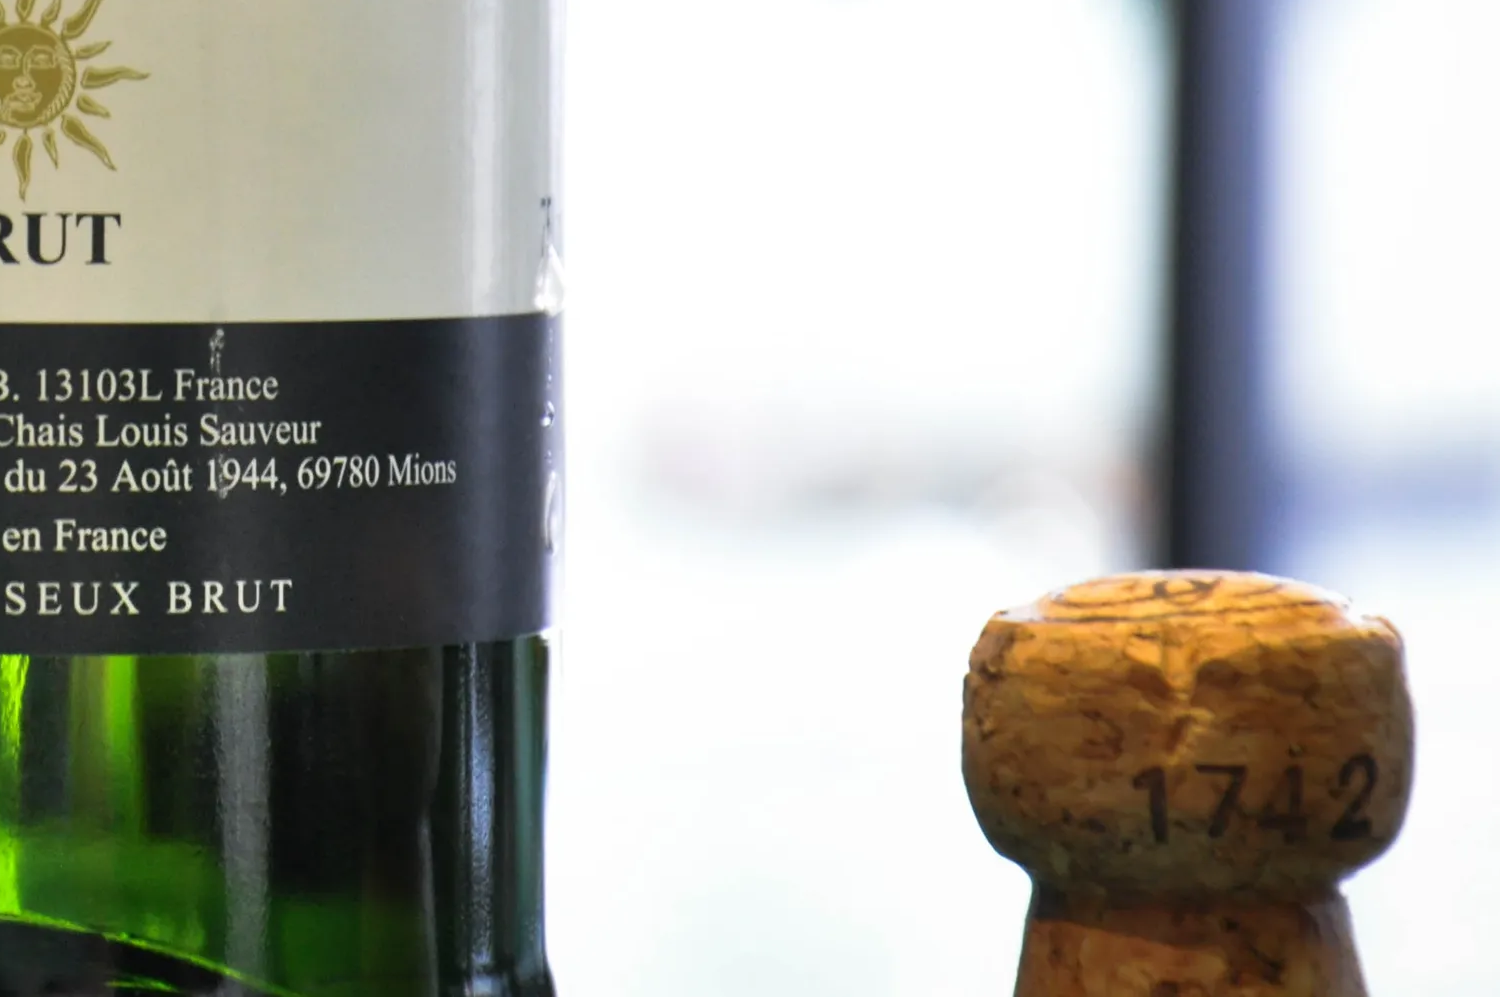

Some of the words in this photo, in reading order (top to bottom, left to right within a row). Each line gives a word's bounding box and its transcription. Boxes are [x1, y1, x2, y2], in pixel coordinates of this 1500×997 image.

[38, 368, 163, 402] 13103L
[175, 368, 279, 401] France
[96, 413, 189, 447] Louis
[200, 413, 322, 447] Sauveur
[4, 458, 47, 493] du
[58, 458, 98, 493] 23
[111, 458, 193, 492] Août
[205, 456, 287, 495] 1944,
[297, 455, 380, 490] 69780
[388, 453, 457, 486] Mions
[2, 527, 42, 552] en
[54, 518, 167, 552] France
[168, 579, 293, 614] BRUT
[1132, 754, 1378, 845] 1742
